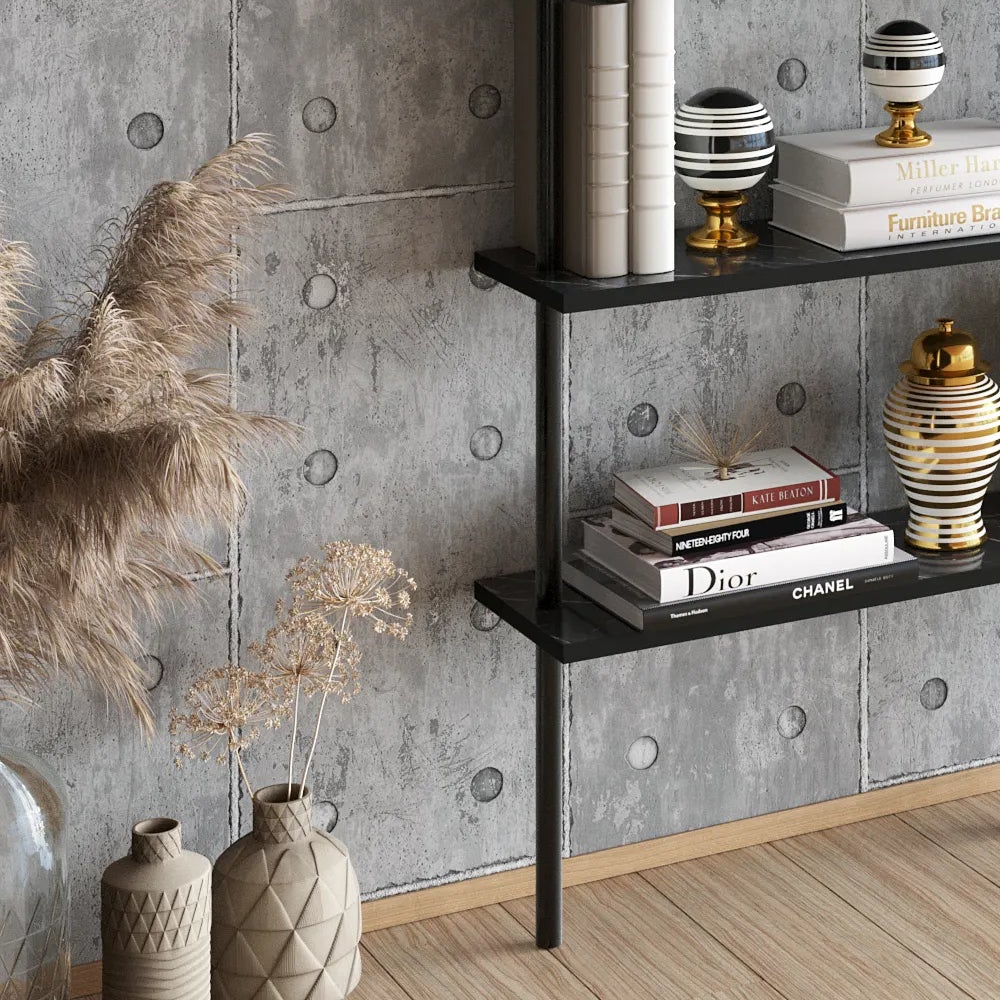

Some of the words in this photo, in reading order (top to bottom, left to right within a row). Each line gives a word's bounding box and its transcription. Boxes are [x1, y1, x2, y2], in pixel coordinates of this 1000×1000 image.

[896, 158, 959, 182] Miller
[910, 181, 964, 196] PERFUMER
[887, 209, 967, 233] Furniture
[752, 492, 775, 506] KATE
[778, 486, 814, 501] BEATON
[675, 532, 732, 552] NINETEEN-EIGHTY
[732, 528, 750, 541] FOUR
[683, 564, 758, 598] Dior
[792, 578, 854, 600] CHANEL
